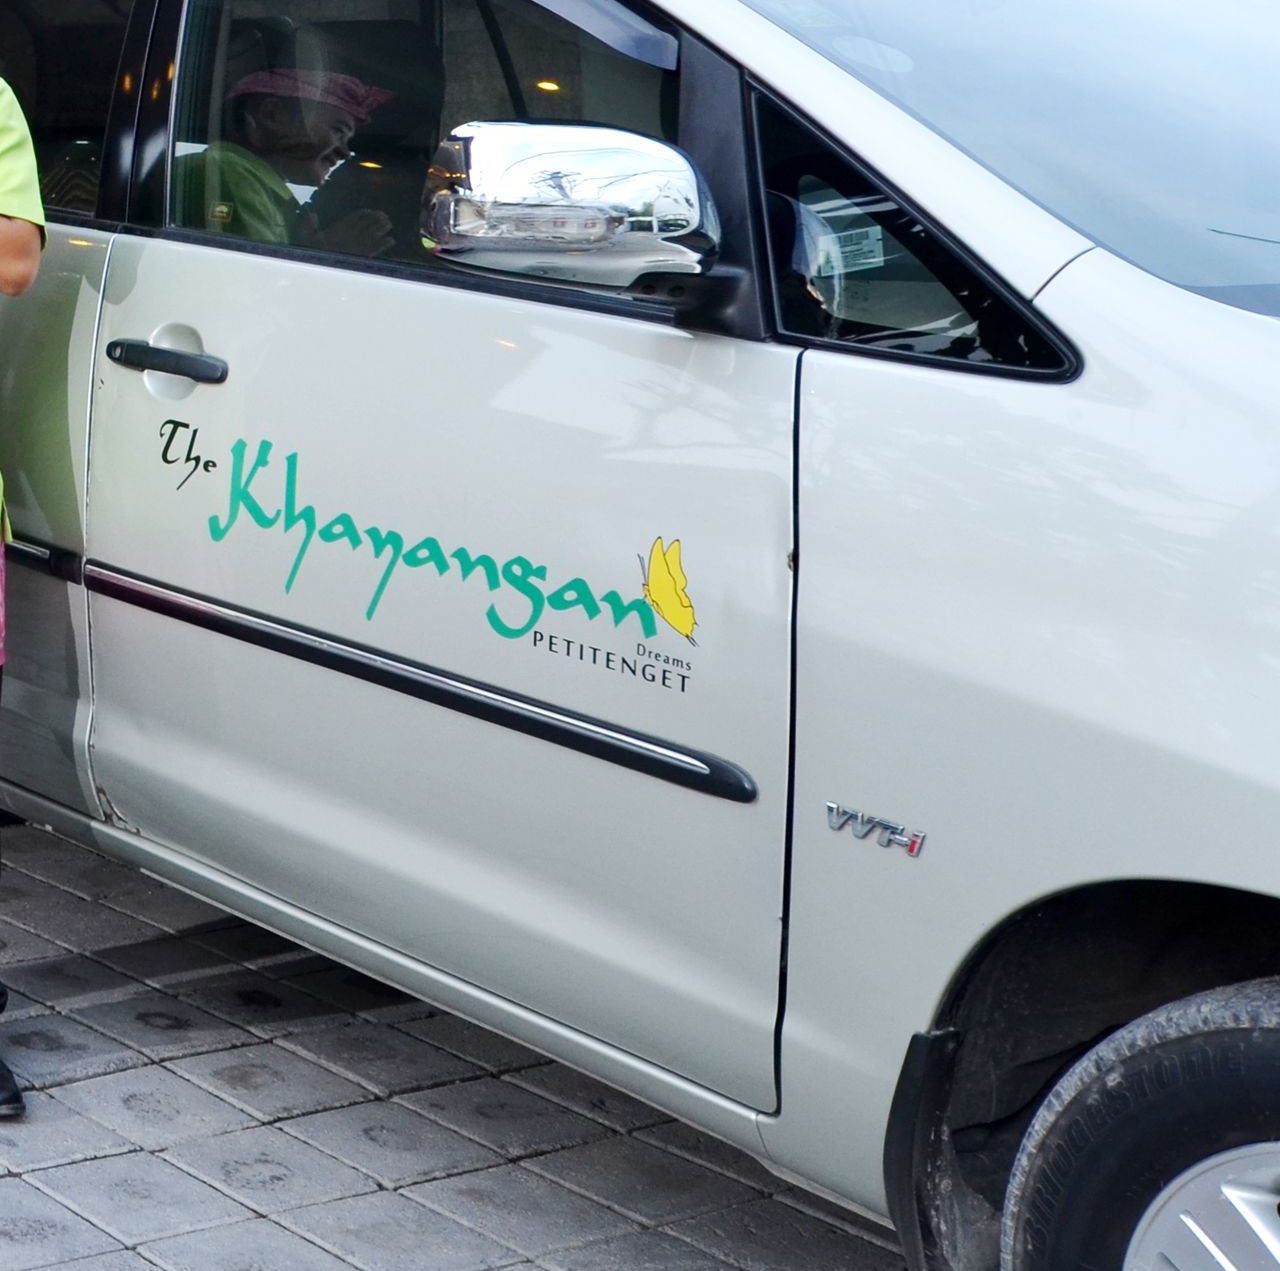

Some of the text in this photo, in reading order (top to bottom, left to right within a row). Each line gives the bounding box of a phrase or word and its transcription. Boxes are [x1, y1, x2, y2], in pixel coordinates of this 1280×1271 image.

[159, 419, 217, 490] The
[533, 630, 690, 693] PETITENGET
[636, 642, 692, 671] Dreams
